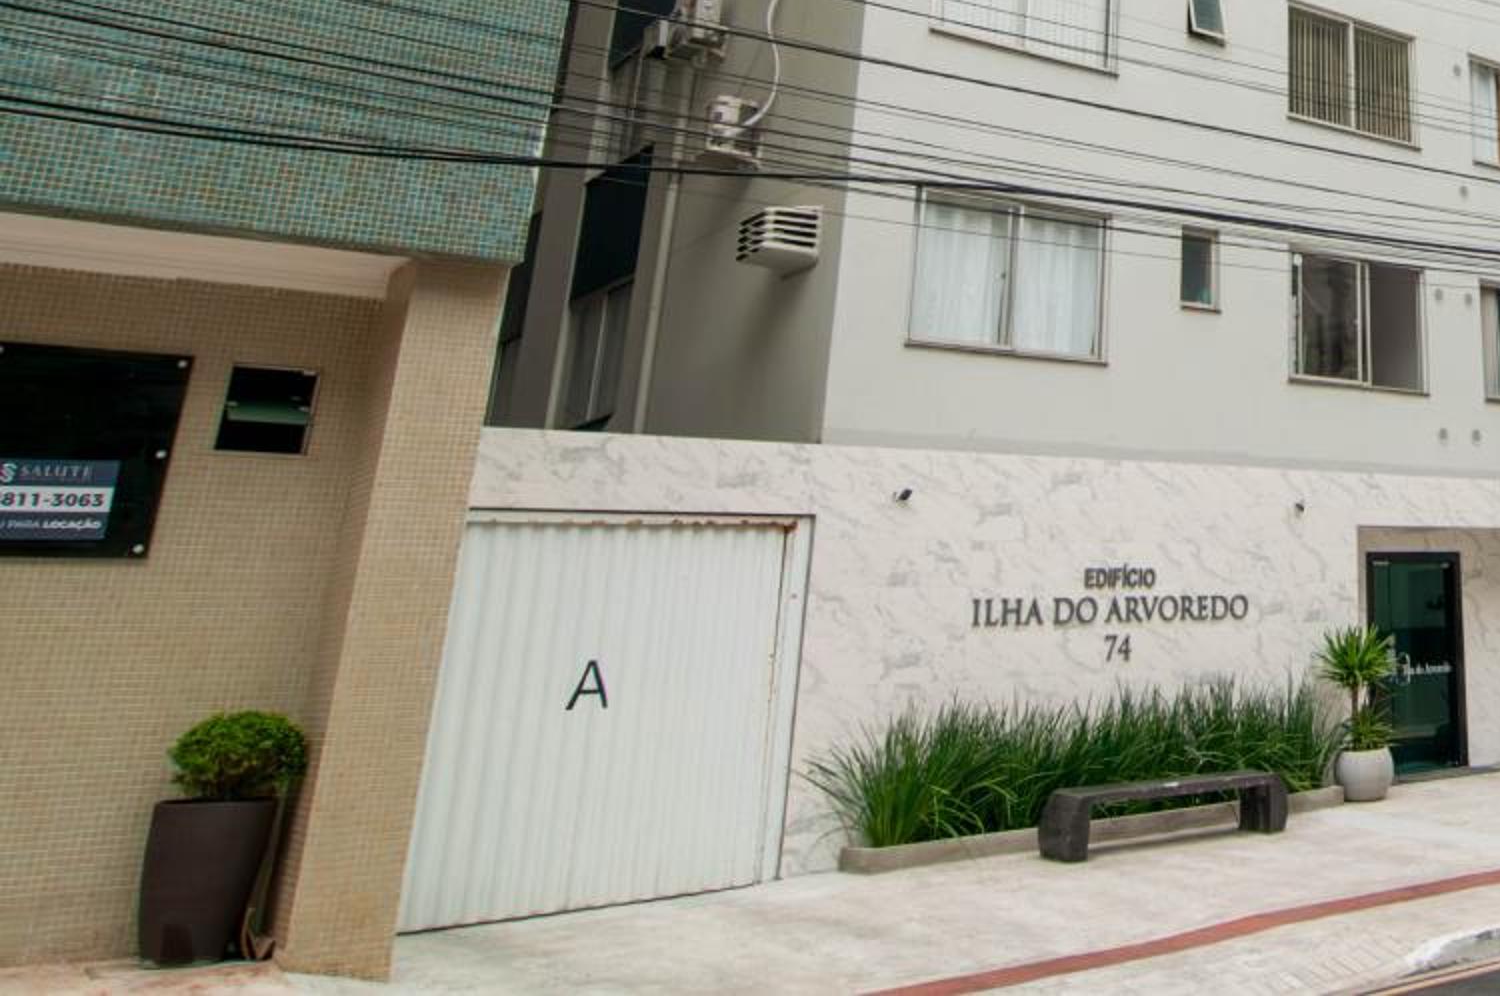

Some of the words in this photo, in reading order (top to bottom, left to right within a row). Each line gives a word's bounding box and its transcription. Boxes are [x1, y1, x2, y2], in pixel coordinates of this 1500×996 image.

[0, 491, 104, 507] 811-3063
[1084, 564, 1156, 589] EDIFÍCIO
[971, 598, 1043, 627] ILHA
[1053, 597, 1098, 625] DO
[1104, 594, 1249, 623] ARVOREDO
[1104, 635, 1132, 662] 74
[565, 659, 608, 710] A
